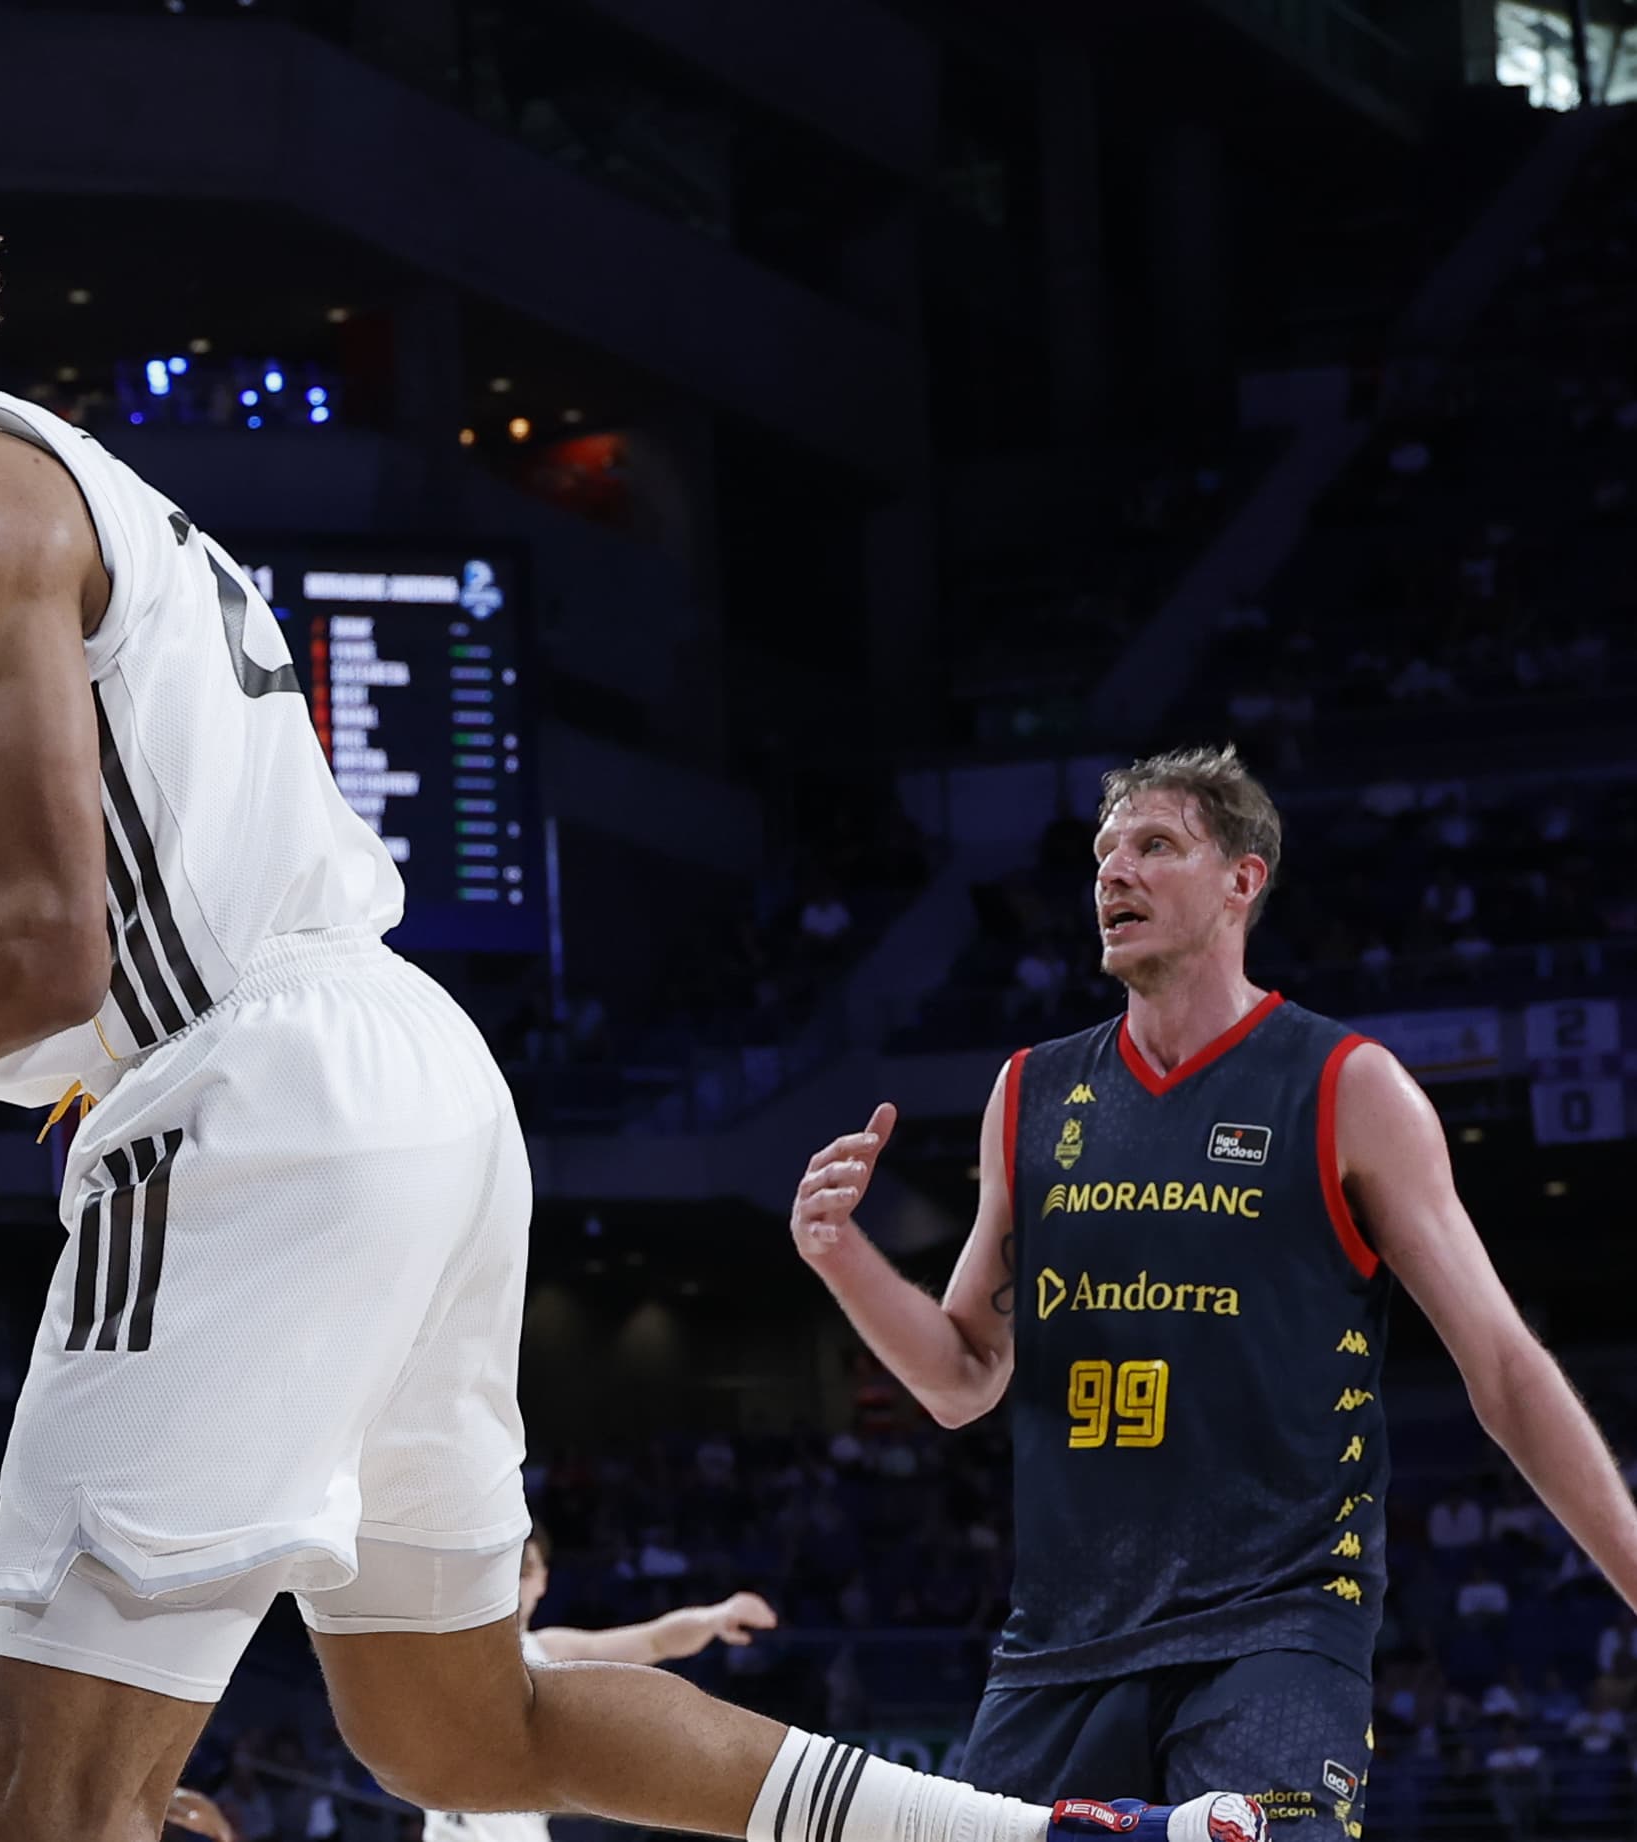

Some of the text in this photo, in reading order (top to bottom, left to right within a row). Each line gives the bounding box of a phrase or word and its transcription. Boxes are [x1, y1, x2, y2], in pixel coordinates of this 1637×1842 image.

[1066, 1181, 1263, 1219] MORABANC
[1070, 1269, 1241, 1316] Andorra
[1067, 1359, 1170, 1449] 99
[1327, 1772, 1350, 1794] acb
[1064, 1803, 1115, 1825] BEYOND
[1267, 1806, 1316, 1819] ecom
